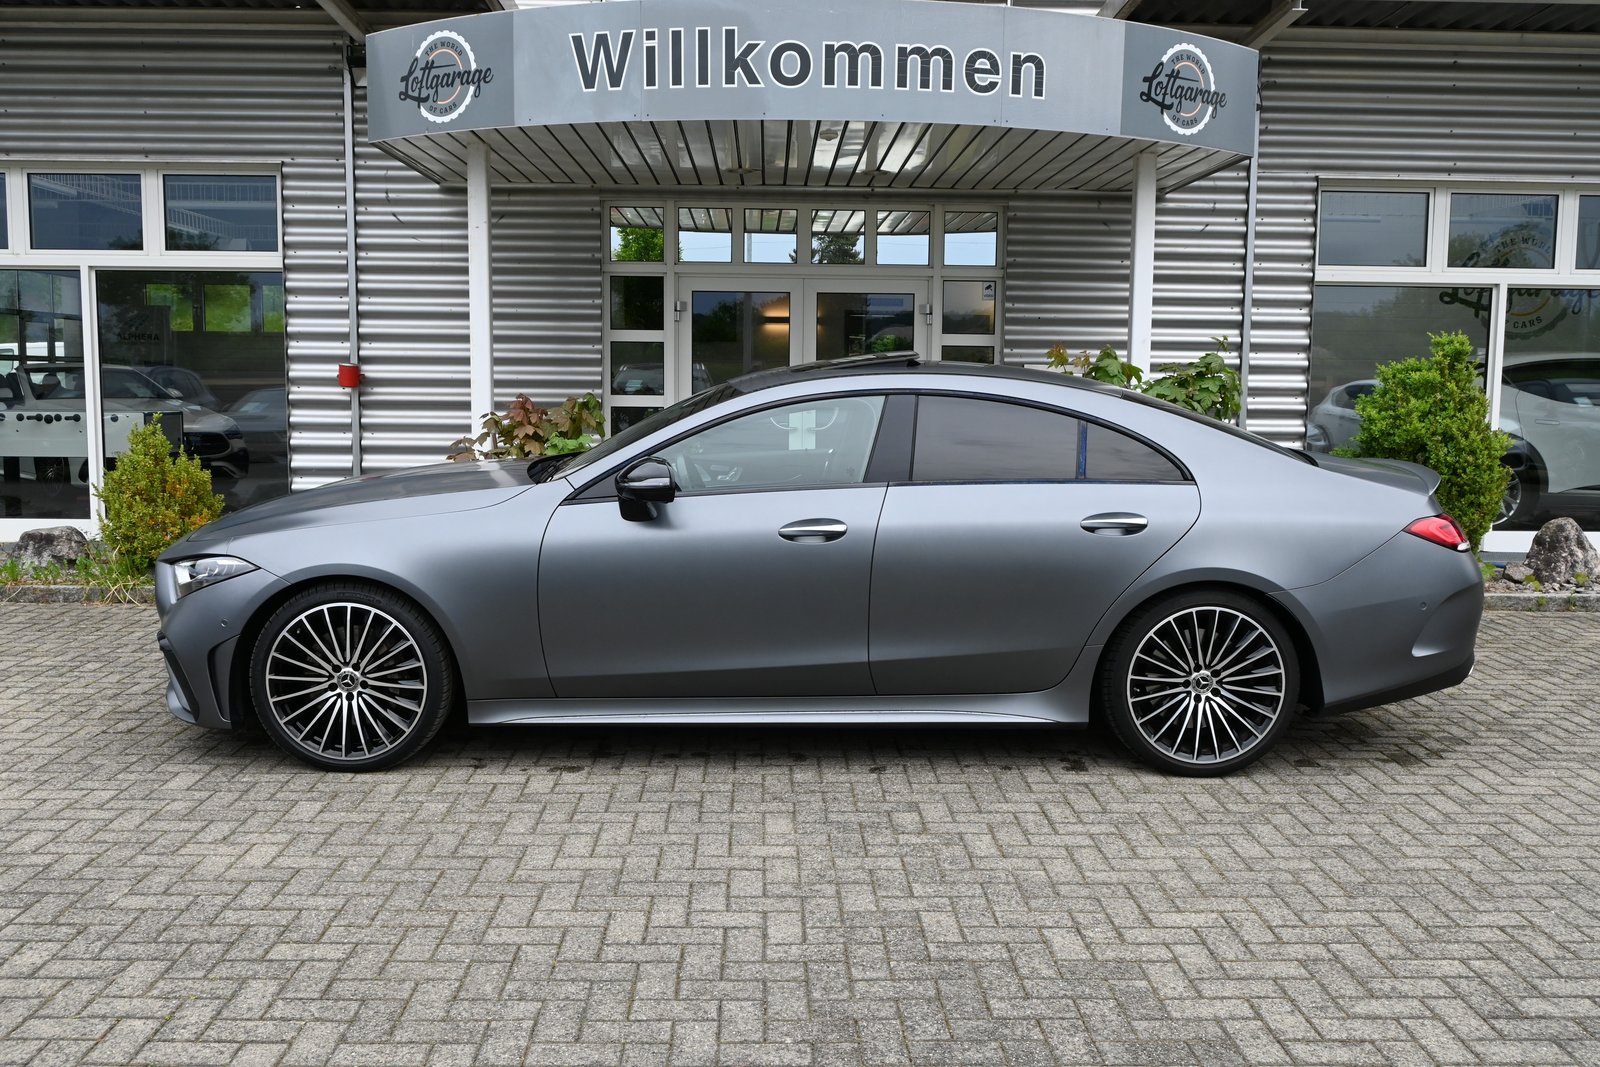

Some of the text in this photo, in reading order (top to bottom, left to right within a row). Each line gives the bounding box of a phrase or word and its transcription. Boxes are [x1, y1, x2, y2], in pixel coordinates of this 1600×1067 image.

[425, 41, 463, 57] THE WORLD
[569, 26, 1046, 100] Willkommen
[1171, 54, 1206, 75] THE WORLD
[399, 56, 494, 109] Loftgarage
[1140, 61, 1228, 119] Loftgarage
[429, 101, 457, 114] OF CARS
[1172, 114, 1198, 126] OF CARS
[1494, 236, 1551, 254] THE WORL
[1513, 315, 1543, 329] CARS
